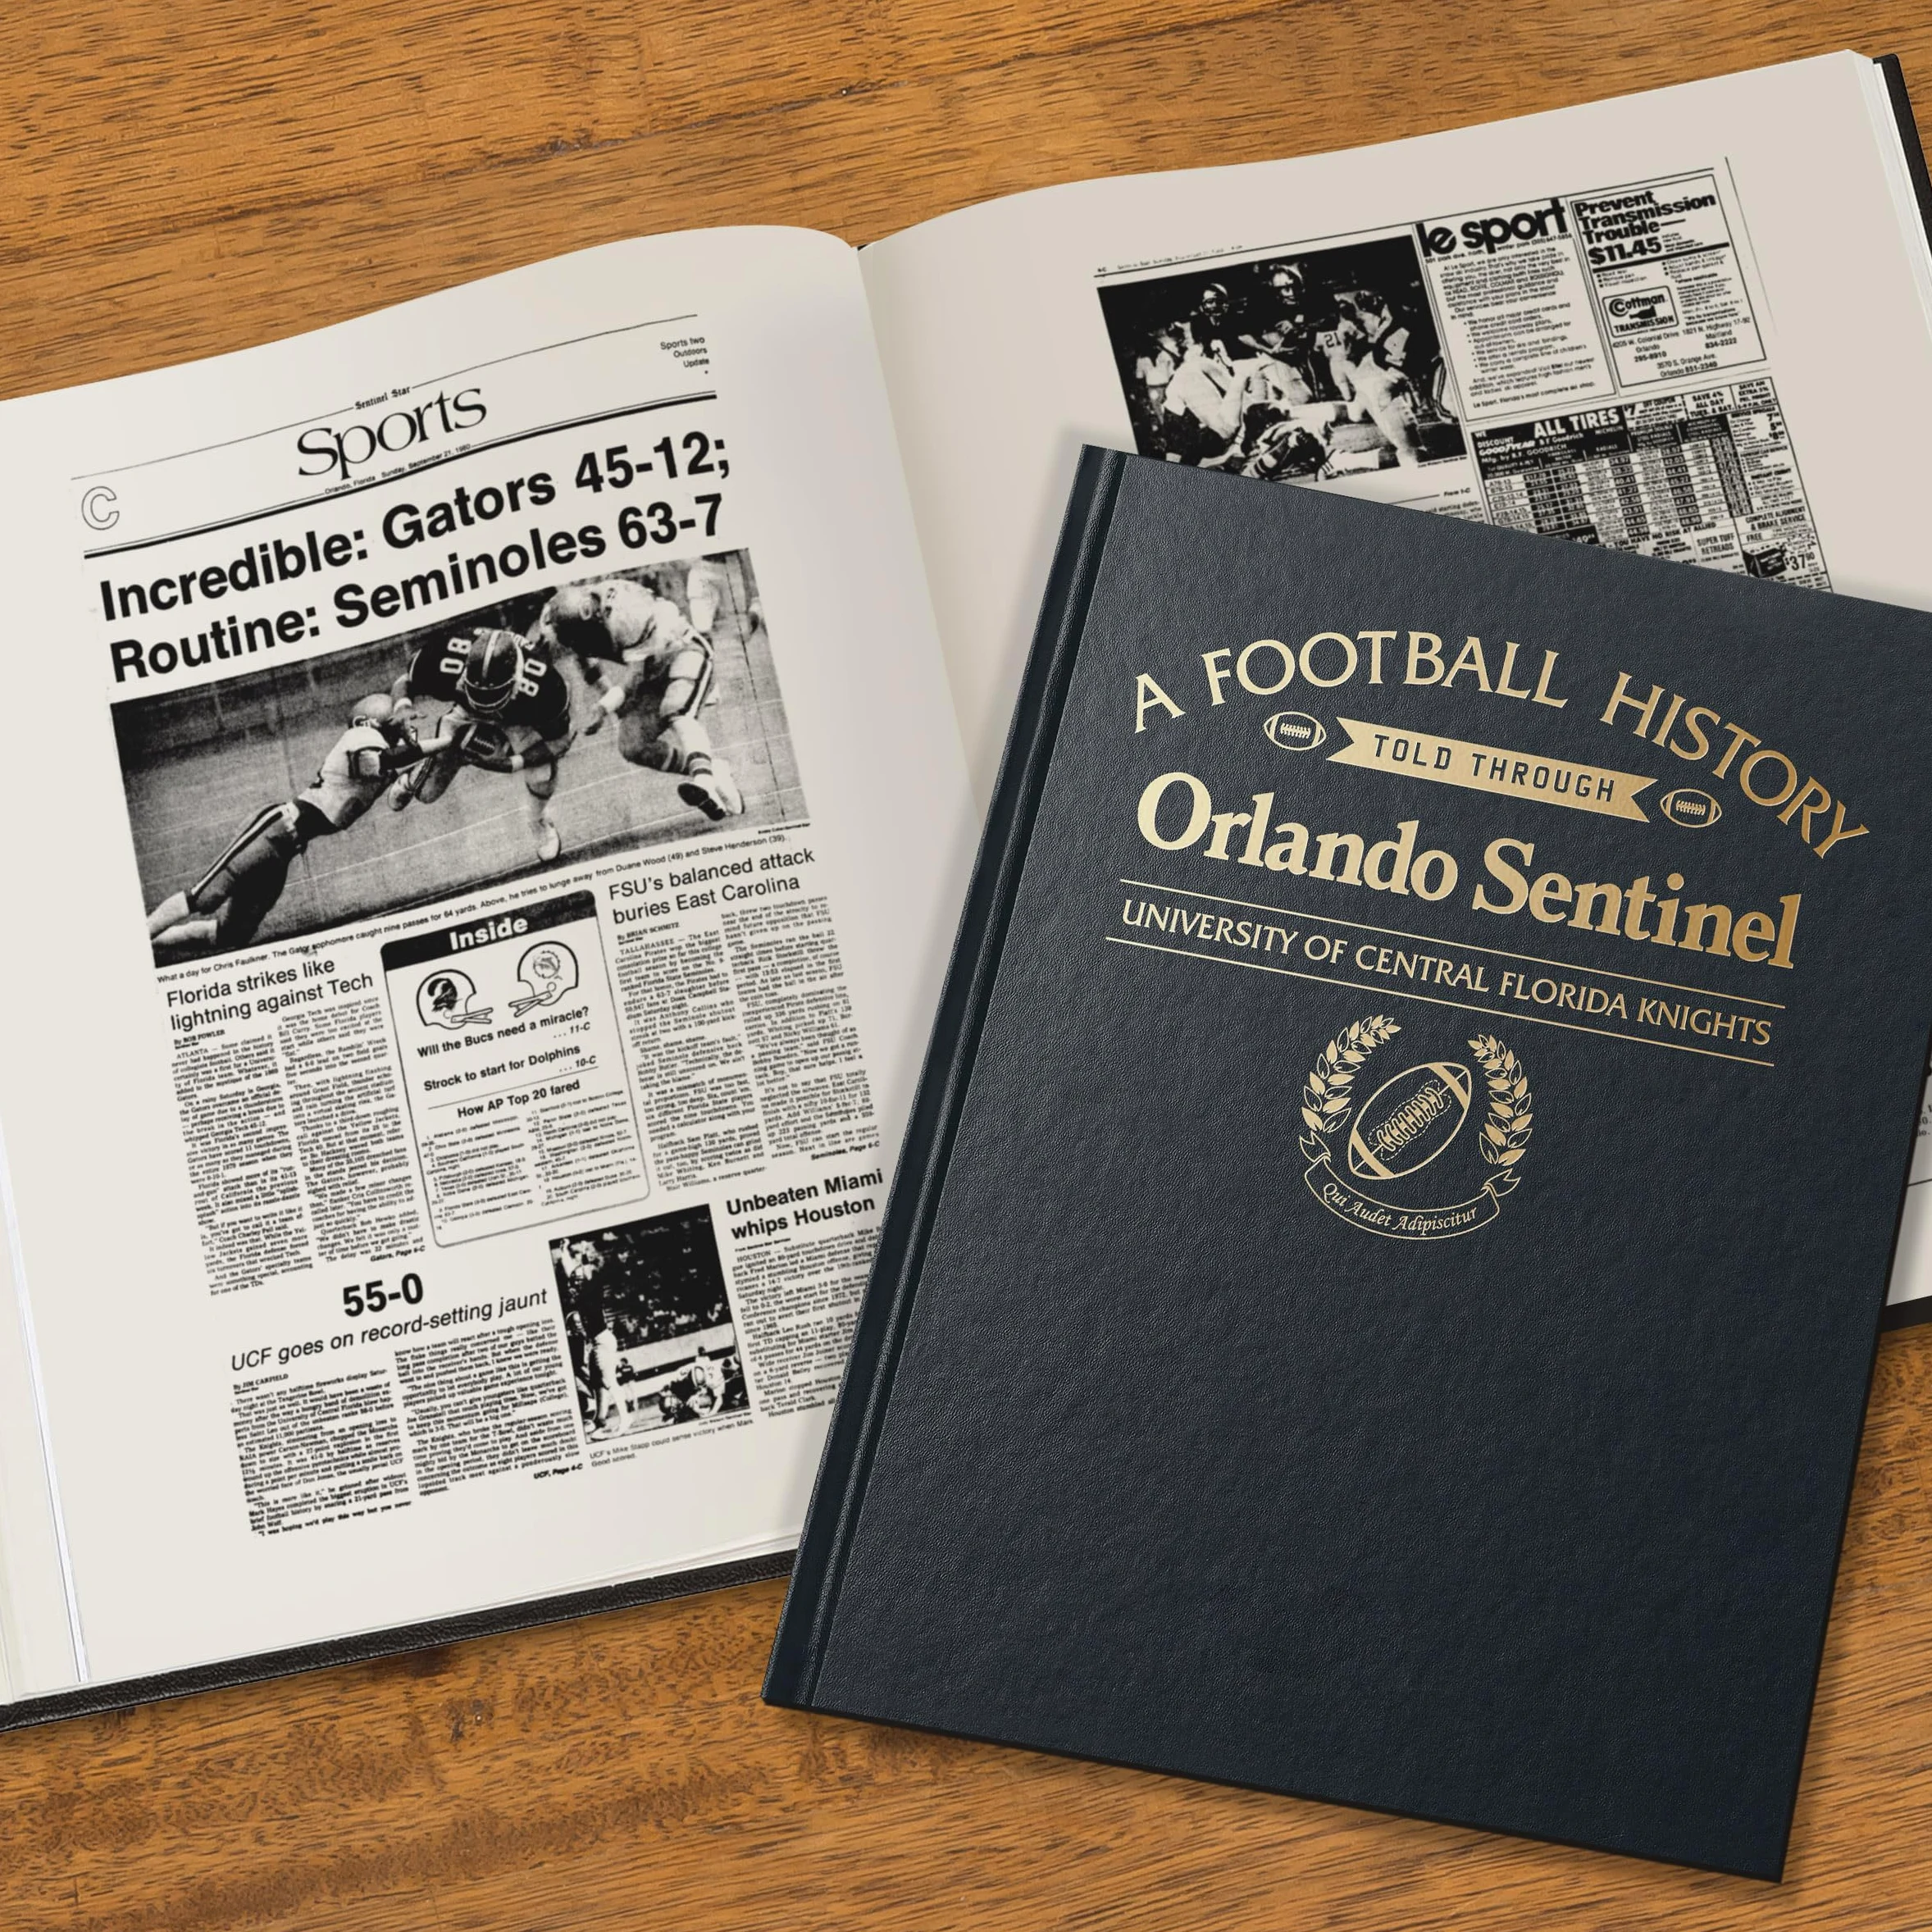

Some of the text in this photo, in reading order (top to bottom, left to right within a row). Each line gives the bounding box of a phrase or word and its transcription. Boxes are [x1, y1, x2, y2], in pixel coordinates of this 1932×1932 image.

[1578, 191, 1656, 215] Prevent
[1579, 194, 1716, 230] Transmission
[1415, 195, 1569, 257] le sport
[1583, 214, 1661, 243] Trouble
[1589, 235, 1663, 267] $11.45
[1608, 293, 1667, 317] Cottman
[1613, 315, 1675, 335] TRANSMISSION
[1637, 333, 1663, 344] Colonial
[1662, 331, 1679, 339] Drive
[659, 336, 705, 350] Sports two
[672, 347, 708, 358] Outdoors
[1634, 344, 1661, 353] Orlando
[1679, 355, 1702, 365] Orange
[1702, 353, 1716, 361] Ave.
[682, 358, 710, 368] Update
[1660, 366, 1684, 377] Orlando
[354, 386, 410, 410] Sentinel Star
[1695, 398, 1725, 409] ALL DAY
[297, 388, 487, 480] Sports
[1534, 420, 1566, 439] ALL
[1570, 408, 1620, 431] TIRES
[1594, 426, 1624, 435] MICHELIN
[1477, 436, 1515, 449] DISCOUNT
[324, 483, 352, 494] Orlando,
[353, 475, 376, 486] Florida
[380, 467, 405, 478] Sunday,
[455, 443, 471, 453] 1980
[81, 485, 120, 531] C
[1745, 512, 1772, 524] COMPLETE
[99, 430, 729, 622] Incredible: Gators 45-12;
[1697, 532, 1735, 547] SUPER TUFF
[1746, 532, 1762, 542] FREE
[1702, 542, 1734, 555] RETREADS
[109, 491, 723, 683] Routine: Seminoles 63-7
[1133, 631, 1870, 859] A FOOTBALL HISTORY
[1374, 736, 1615, 803] TOLD THROUGH
[608, 847, 815, 900] FSU's balanced attack
[1136, 771, 1802, 969] Orlando Sentinel
[156, 973, 178, 983] What
[185, 969, 199, 977] day
[212, 962, 234, 972] Chris
[235, 954, 268, 966] Faulkner.
[271, 950, 288, 958] The
[288, 945, 310, 955] Gator
[355, 927, 383, 940] caught
[383, 923, 401, 933] nine
[402, 917, 430, 930] passes
[430, 913, 442, 921] for
[443, 909, 453, 918] 64
[454, 904, 477, 917] yards.
[480, 896, 505, 908] Above,
[520, 887, 538, 897] tries
[549, 878, 572, 889] lunge
[572, 873, 593, 883] away
[595, 867, 614, 877] from
[615, 861, 642, 873] Duane
[642, 855, 667, 866] Wood
[667, 852, 684, 863] (49)
[685, 848, 700, 858] and
[700, 845, 723, 855] Steve
[724, 837, 768, 850] Henderson
[768, 834, 786, 844] (39).
[612, 877, 800, 925] buries East Carolina
[449, 916, 529, 951] Inside
[166, 959, 335, 1008] Florida strikes like
[1122, 898, 1771, 1046] UNIVERSITY OF CENTRAL FLORIDA KNIGHTS
[170, 973, 373, 1032] lightning against Tech
[417, 1005, 589, 1058] Will the Bucs need a miracle?
[569, 1021, 590, 1034] 11-C
[423, 1045, 581, 1091] Strock to start for Dolphins
[575, 1055, 596, 1068] 10-C
[457, 1078, 581, 1119] How AP Top 20 fared
[726, 1168, 883, 1216] Unbeaten Miami
[731, 1197, 876, 1240] whips Houston
[1323, 1182, 1477, 1236] Qui Audet Adipiscitur
[343, 1272, 424, 1318] 55-0
[231, 1288, 547, 1371] UCF goes on record-setting jaunt
[651, 1437, 671, 1447] could
[672, 1433, 692, 1442] sense
[717, 1423, 736, 1431] when
[590, 1457, 611, 1467] Good
